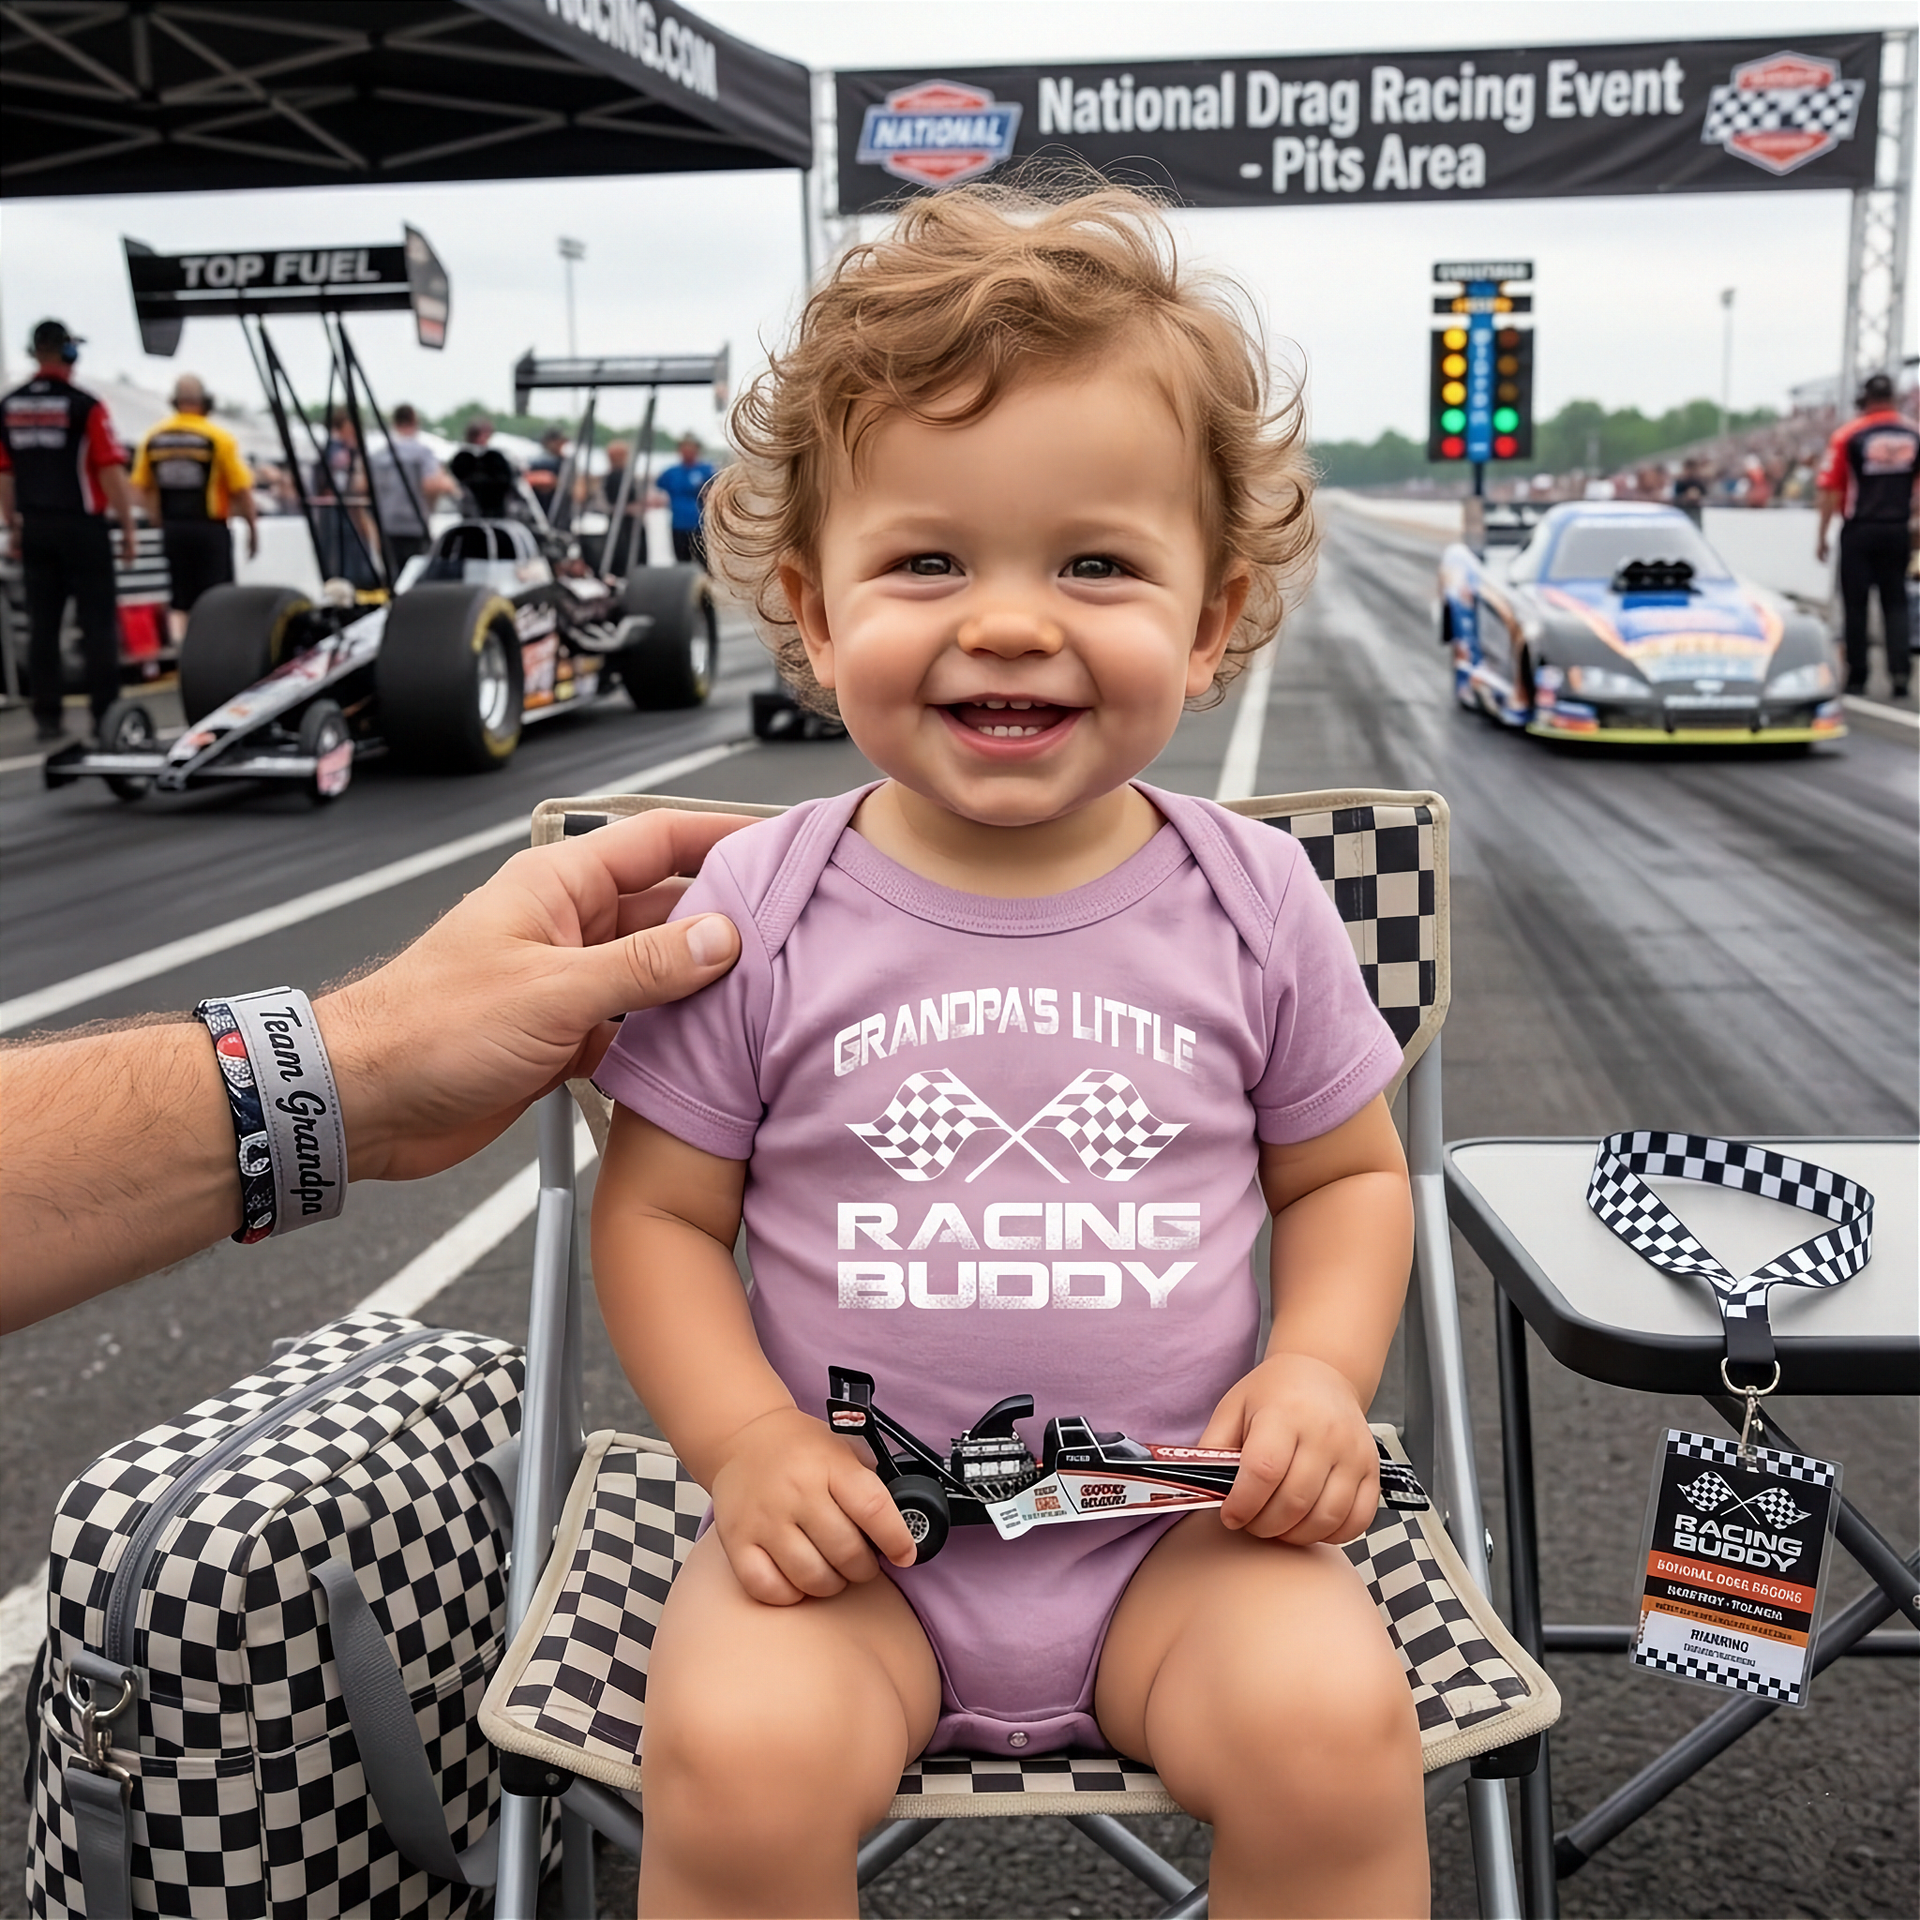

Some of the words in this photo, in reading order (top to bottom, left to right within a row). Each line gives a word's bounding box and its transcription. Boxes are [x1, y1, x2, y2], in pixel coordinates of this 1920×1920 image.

[1037, 71, 1235, 135] National
[1246, 69, 1359, 138] Drag
[1370, 61, 1536, 133] Racing
[1546, 57, 1685, 118] Event
[872, 115, 1003, 148] NATIONAL
[1272, 134, 1365, 193] Pits
[1372, 132, 1487, 191] Area
[180, 254, 264, 288] TOP
[273, 250, 381, 285] FUEL
[259, 1006, 303, 1083] Team
[834, 986, 1059, 1077] GRANDPA'S
[1072, 991, 1197, 1075] LITTLE
[275, 1090, 336, 1216] Grandpa
[837, 1202, 1200, 1250] RACING
[837, 1261, 1199, 1310] BUDDY
[1673, 1531, 1797, 1573] BUDDY
[1674, 1513, 1803, 1557] RACING
